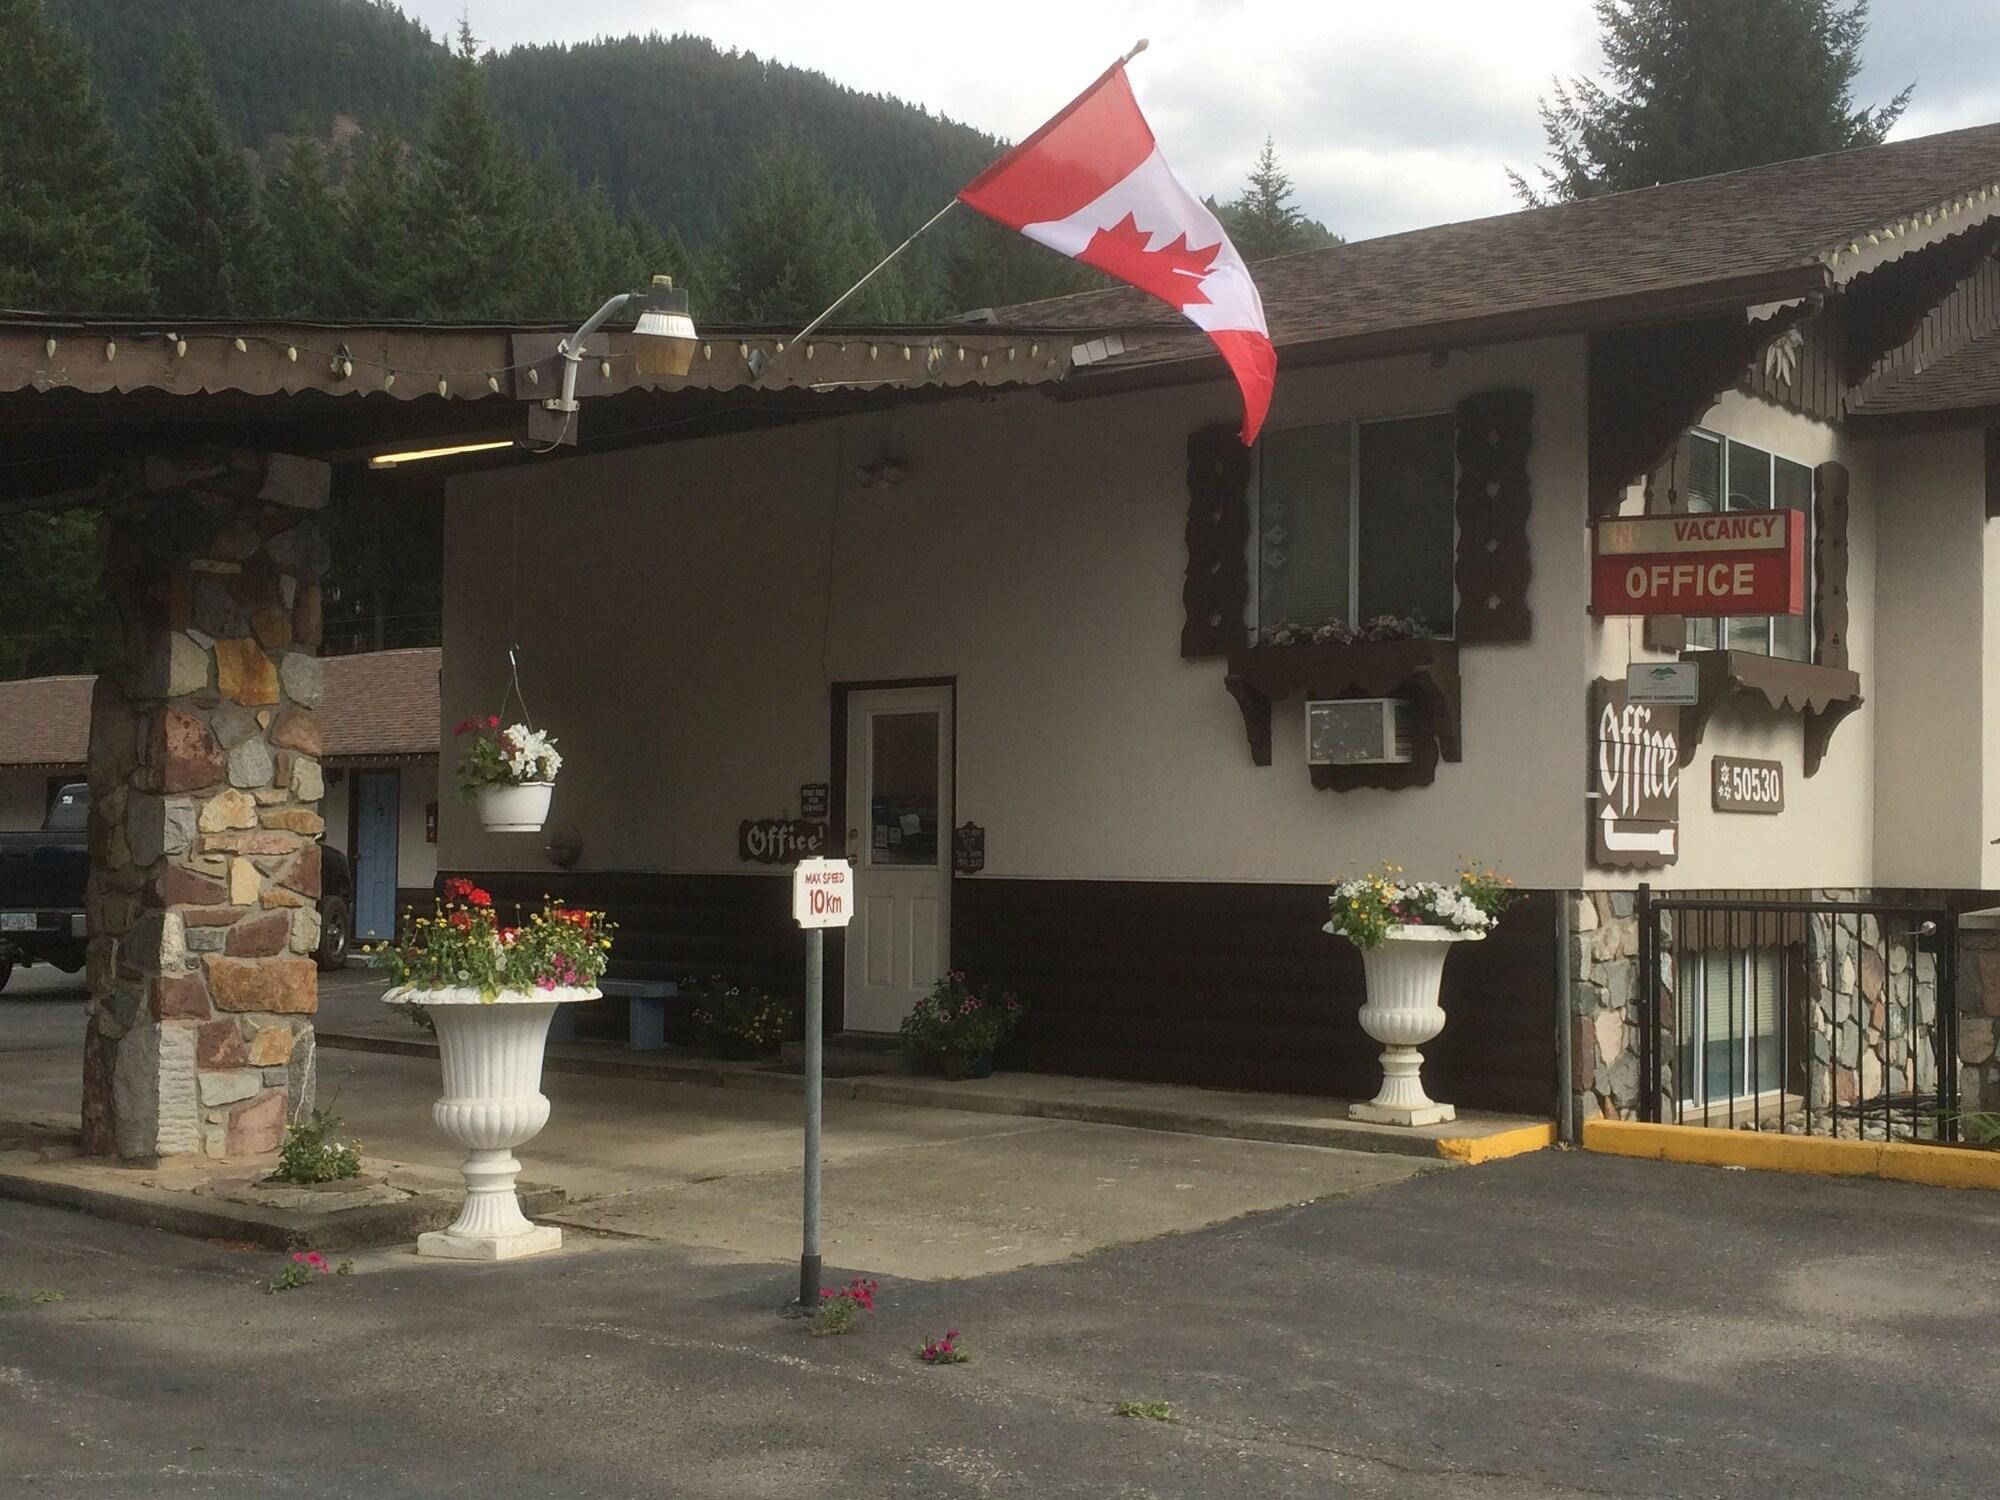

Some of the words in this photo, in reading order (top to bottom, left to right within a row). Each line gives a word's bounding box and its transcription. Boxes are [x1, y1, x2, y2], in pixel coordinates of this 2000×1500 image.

[1674, 516, 1777, 542] VACANCY
[1625, 563, 1754, 599] OFFICE
[1599, 701, 1678, 817] Office
[1733, 767, 1780, 803] 50530
[805, 873, 821, 885] MAX
[822, 872, 845, 885] SPEED
